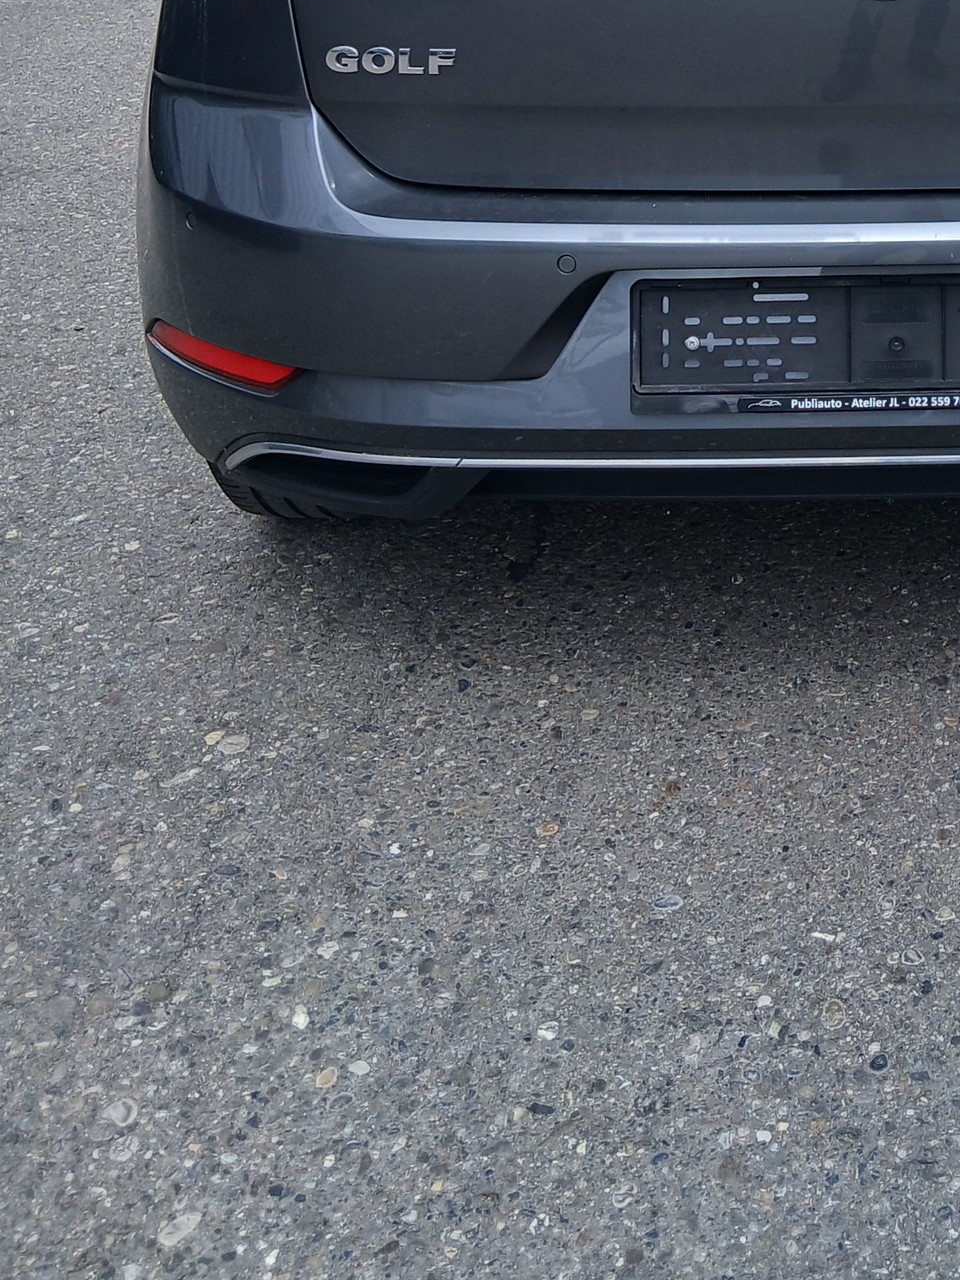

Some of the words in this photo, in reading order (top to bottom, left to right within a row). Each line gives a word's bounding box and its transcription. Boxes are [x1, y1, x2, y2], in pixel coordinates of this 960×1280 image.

[325, 45, 457, 75] GOLF
[791, 398, 842, 409] Publiauto
[851, 397, 887, 408] Atelier
[889, 397, 900, 407] JL
[908, 397, 928, 407] 022
[930, 397, 950, 407] 559
